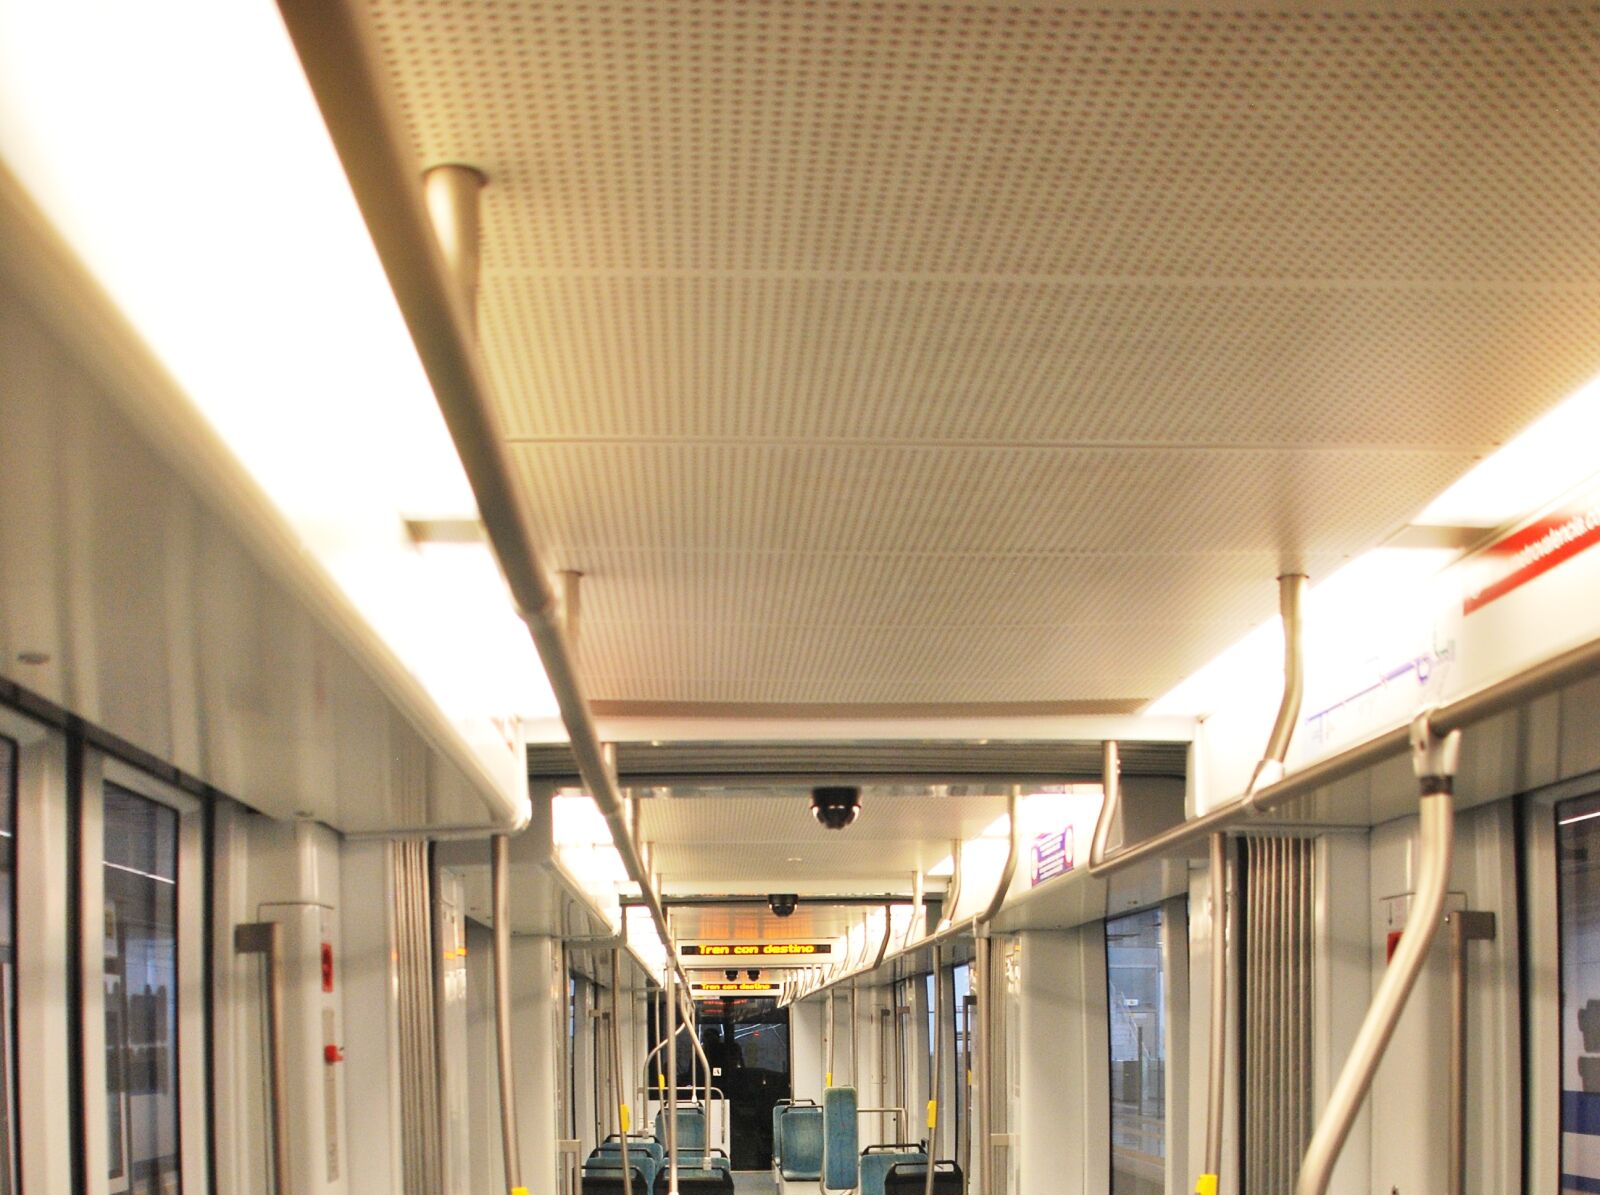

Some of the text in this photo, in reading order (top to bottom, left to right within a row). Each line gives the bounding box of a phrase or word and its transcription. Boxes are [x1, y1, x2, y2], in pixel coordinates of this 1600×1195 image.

[698, 944, 815, 954] Tren con destino
